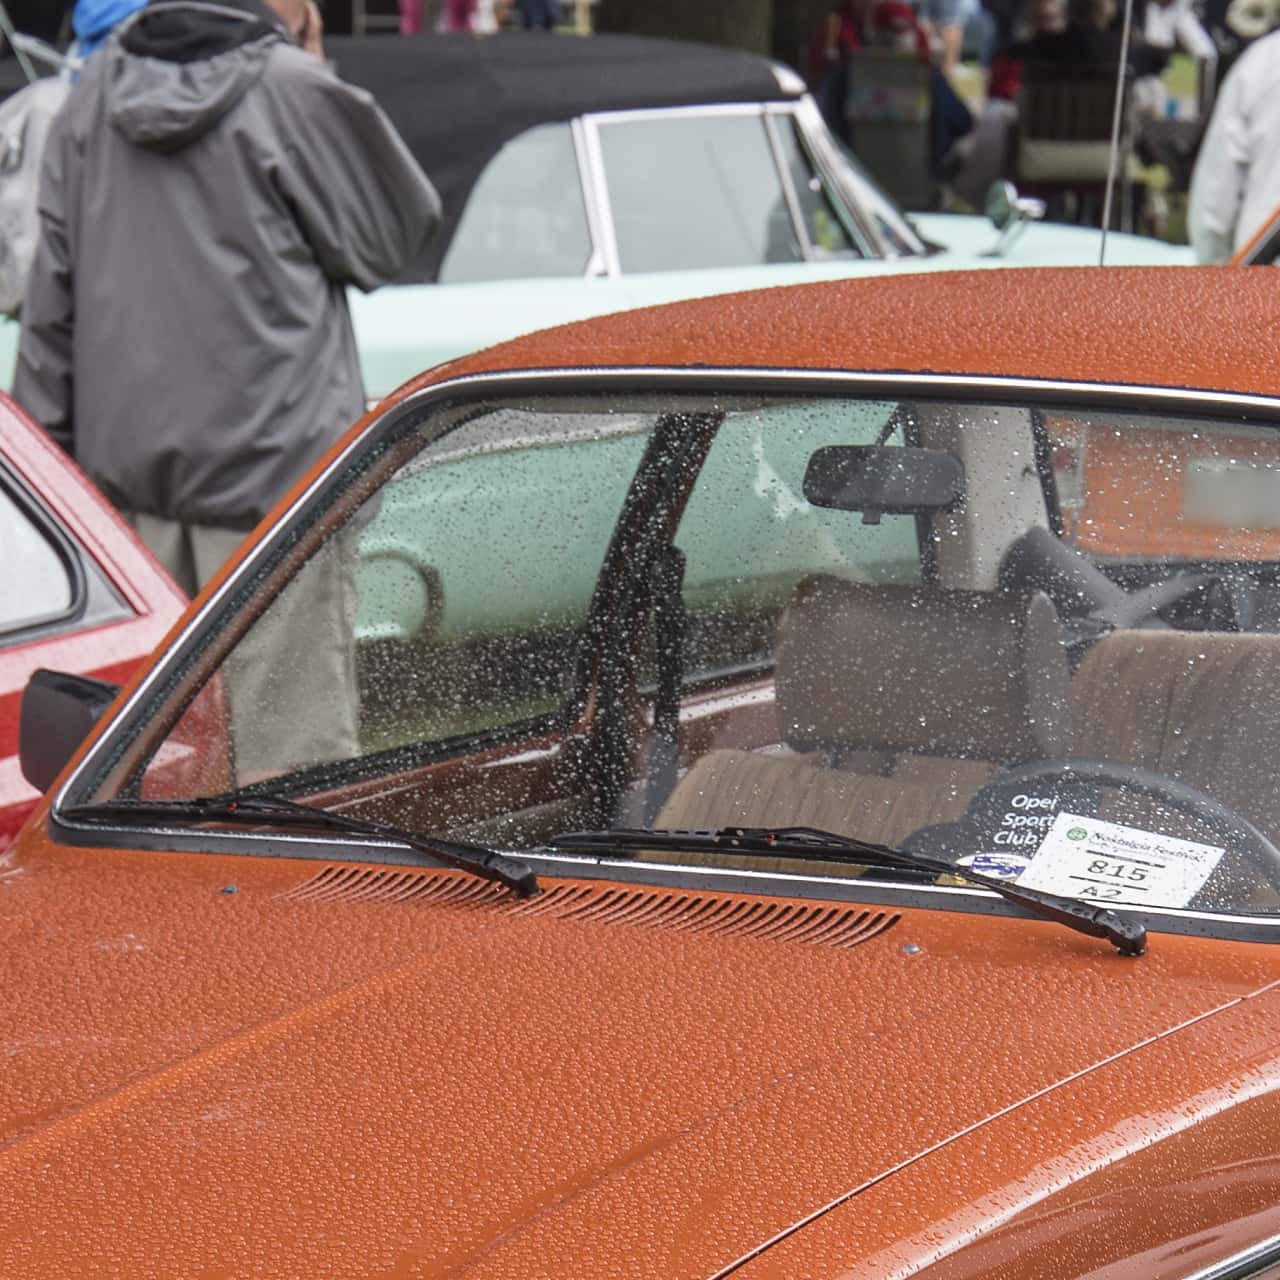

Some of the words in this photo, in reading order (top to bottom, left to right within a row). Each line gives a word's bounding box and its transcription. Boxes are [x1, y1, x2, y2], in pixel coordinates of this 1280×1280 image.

[1011, 794, 1058, 810] Opel
[1001, 812, 1056, 829] Sport
[993, 830, 1038, 845] Club
[1086, 859, 1149, 881] 815
[1077, 885, 1123, 899] A2
